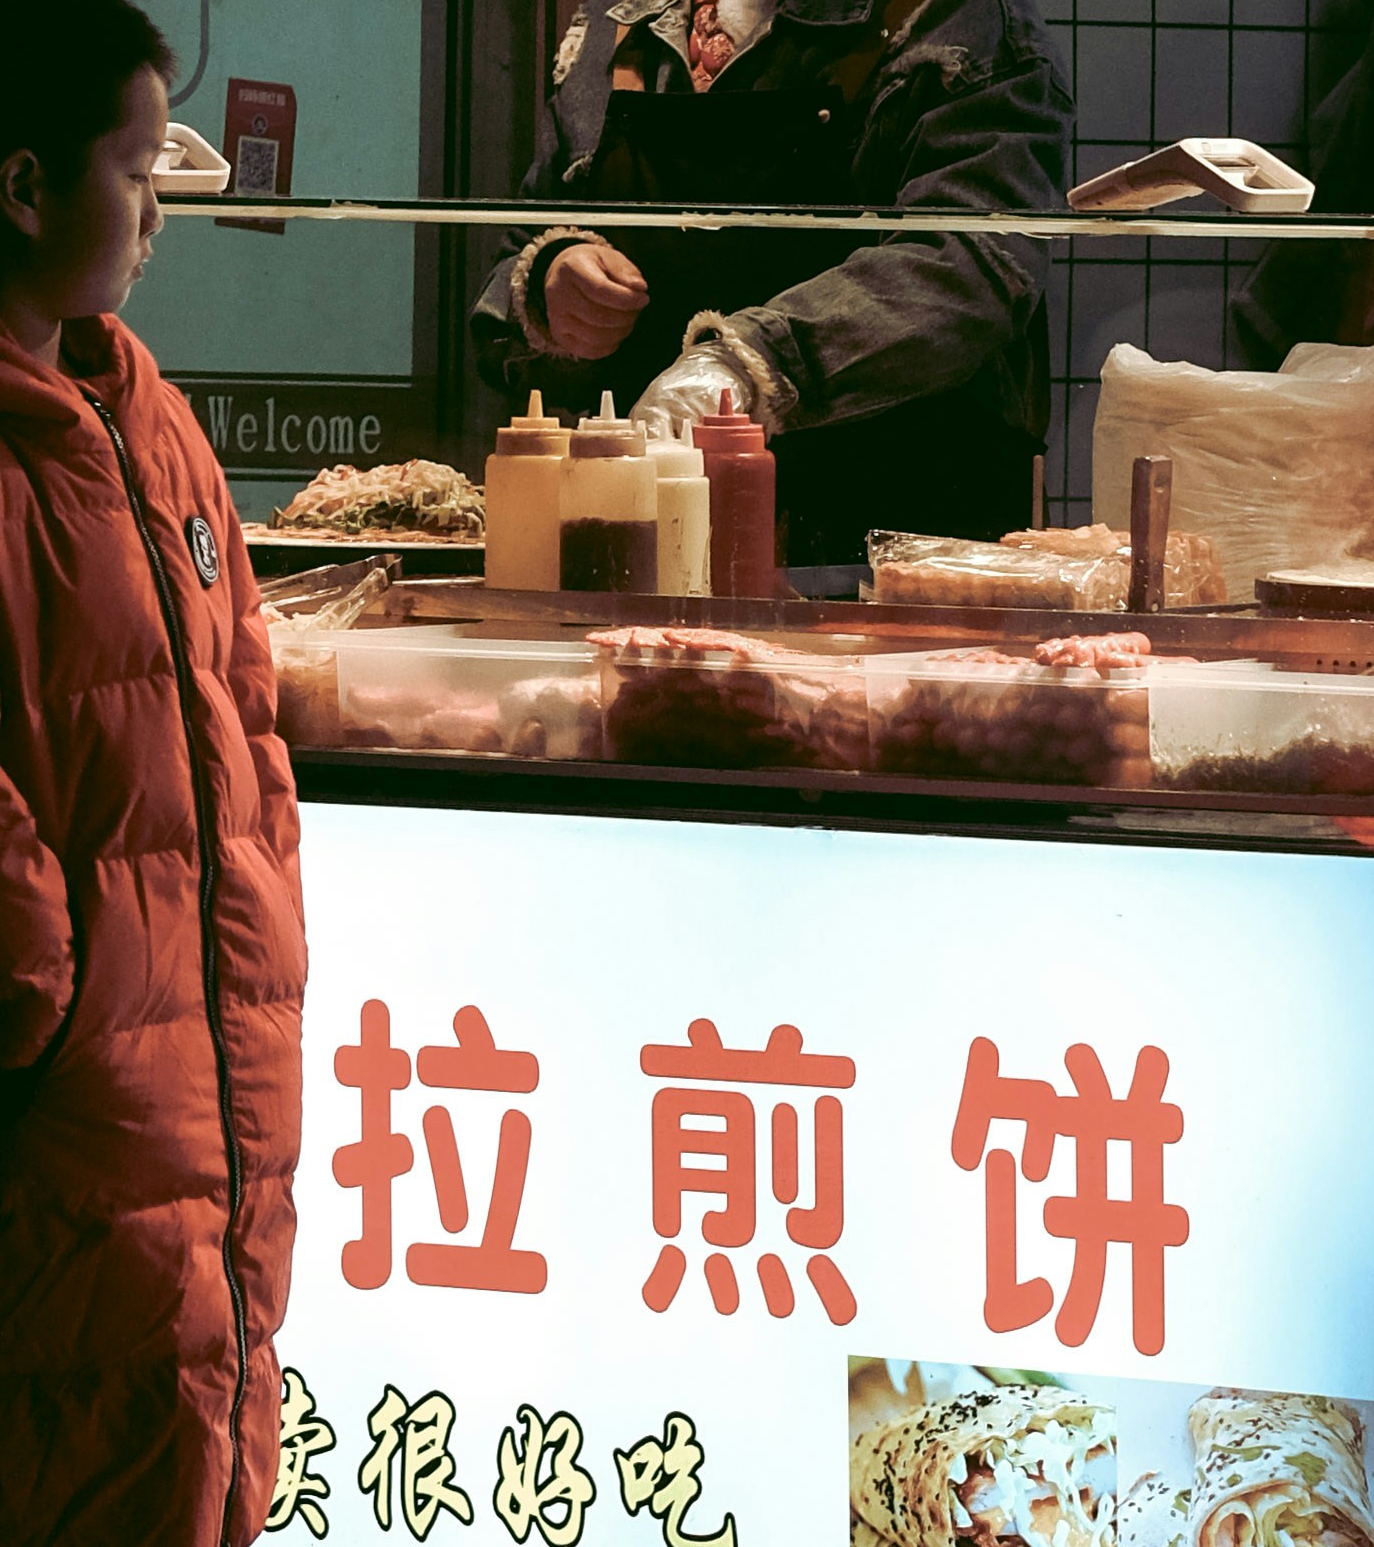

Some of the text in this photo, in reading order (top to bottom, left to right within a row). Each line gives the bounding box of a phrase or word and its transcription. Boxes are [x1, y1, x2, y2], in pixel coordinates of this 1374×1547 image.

[208, 393, 382, 455] Welcome
[333, 998, 1191, 1357] 拉煎饼
